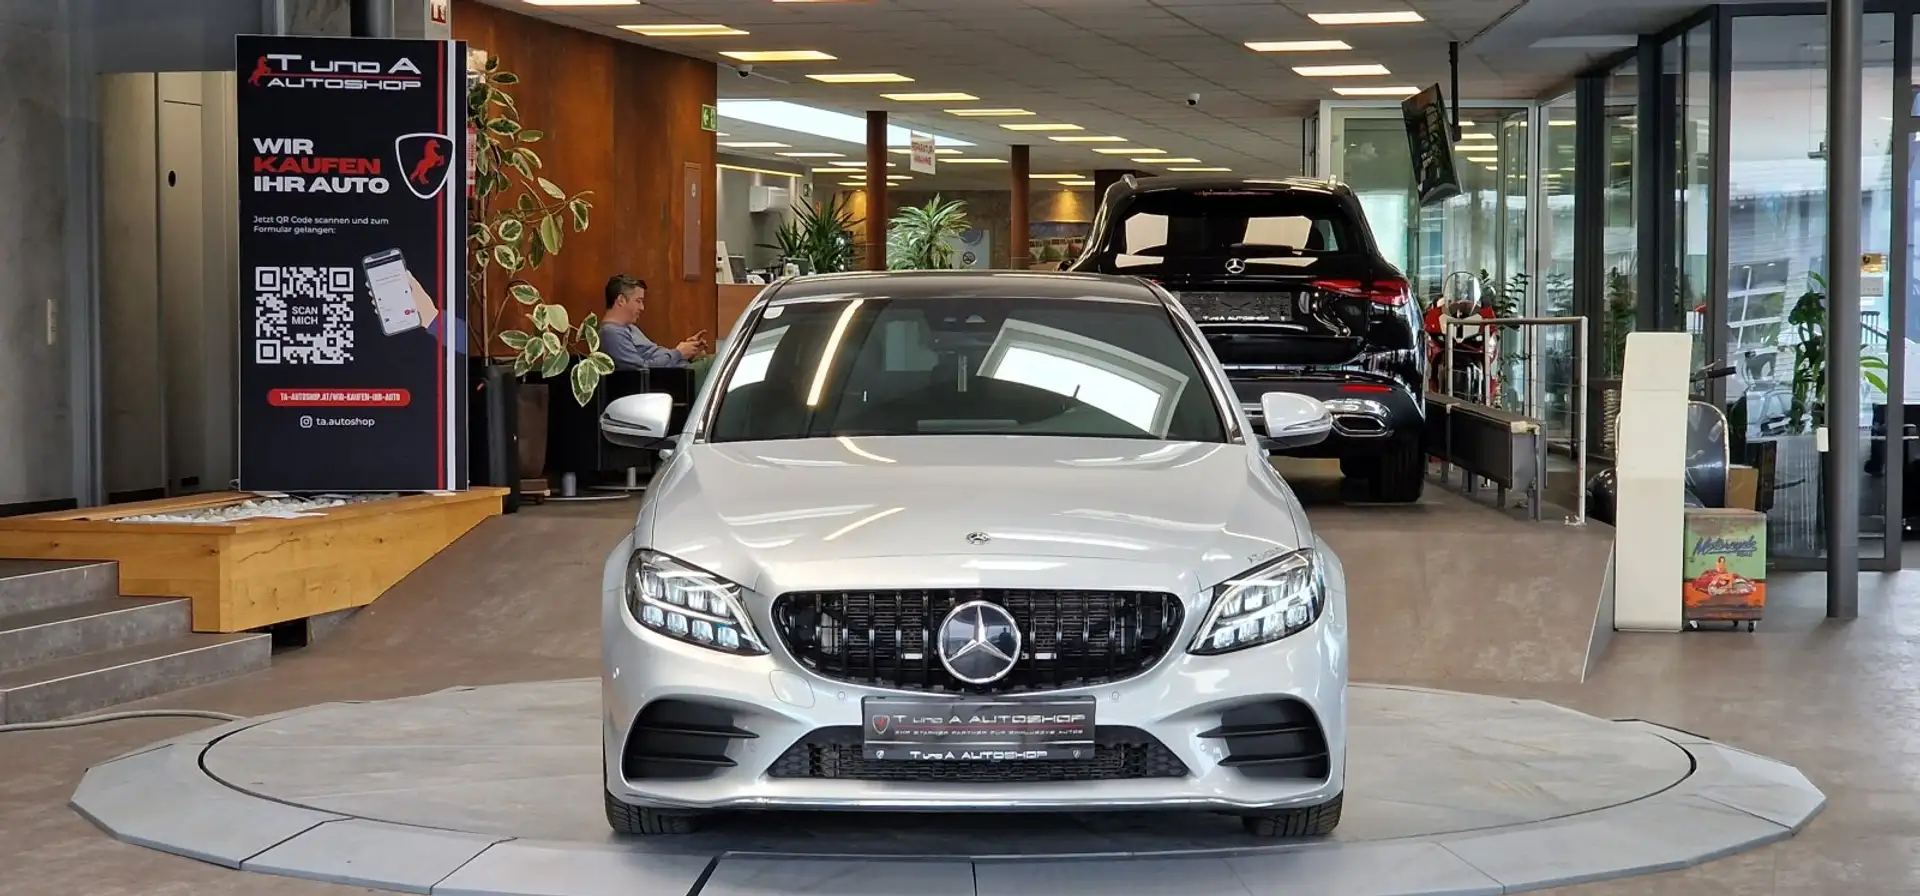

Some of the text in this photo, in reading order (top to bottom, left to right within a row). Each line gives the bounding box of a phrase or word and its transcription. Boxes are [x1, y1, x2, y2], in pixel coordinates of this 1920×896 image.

[266, 54, 302, 71] T
[388, 57, 422, 74] A
[266, 77, 422, 91] AUTOSHOP
[253, 138, 314, 155] WIR
[254, 156, 381, 174] KAUFEN
[254, 176, 390, 194] IHR AUTO
[253, 215, 274, 224] Jetzt
[275, 215, 290, 225] QR
[290, 215, 313, 224] Code
[314, 217, 351, 225] scannen
[351, 216, 369, 225] und
[253, 225, 337, 235] Formular gelangen:
[291, 306, 318, 315] SCAN
[291, 316, 318, 325] MICH
[315, 417, 375, 428] ta.autoshop
[892, 714, 908, 724] T
[948, 715, 962, 724] A
[968, 714, 1086, 724] AUTOSHOP
[961, 750, 1048, 760] AUTOSHOP
